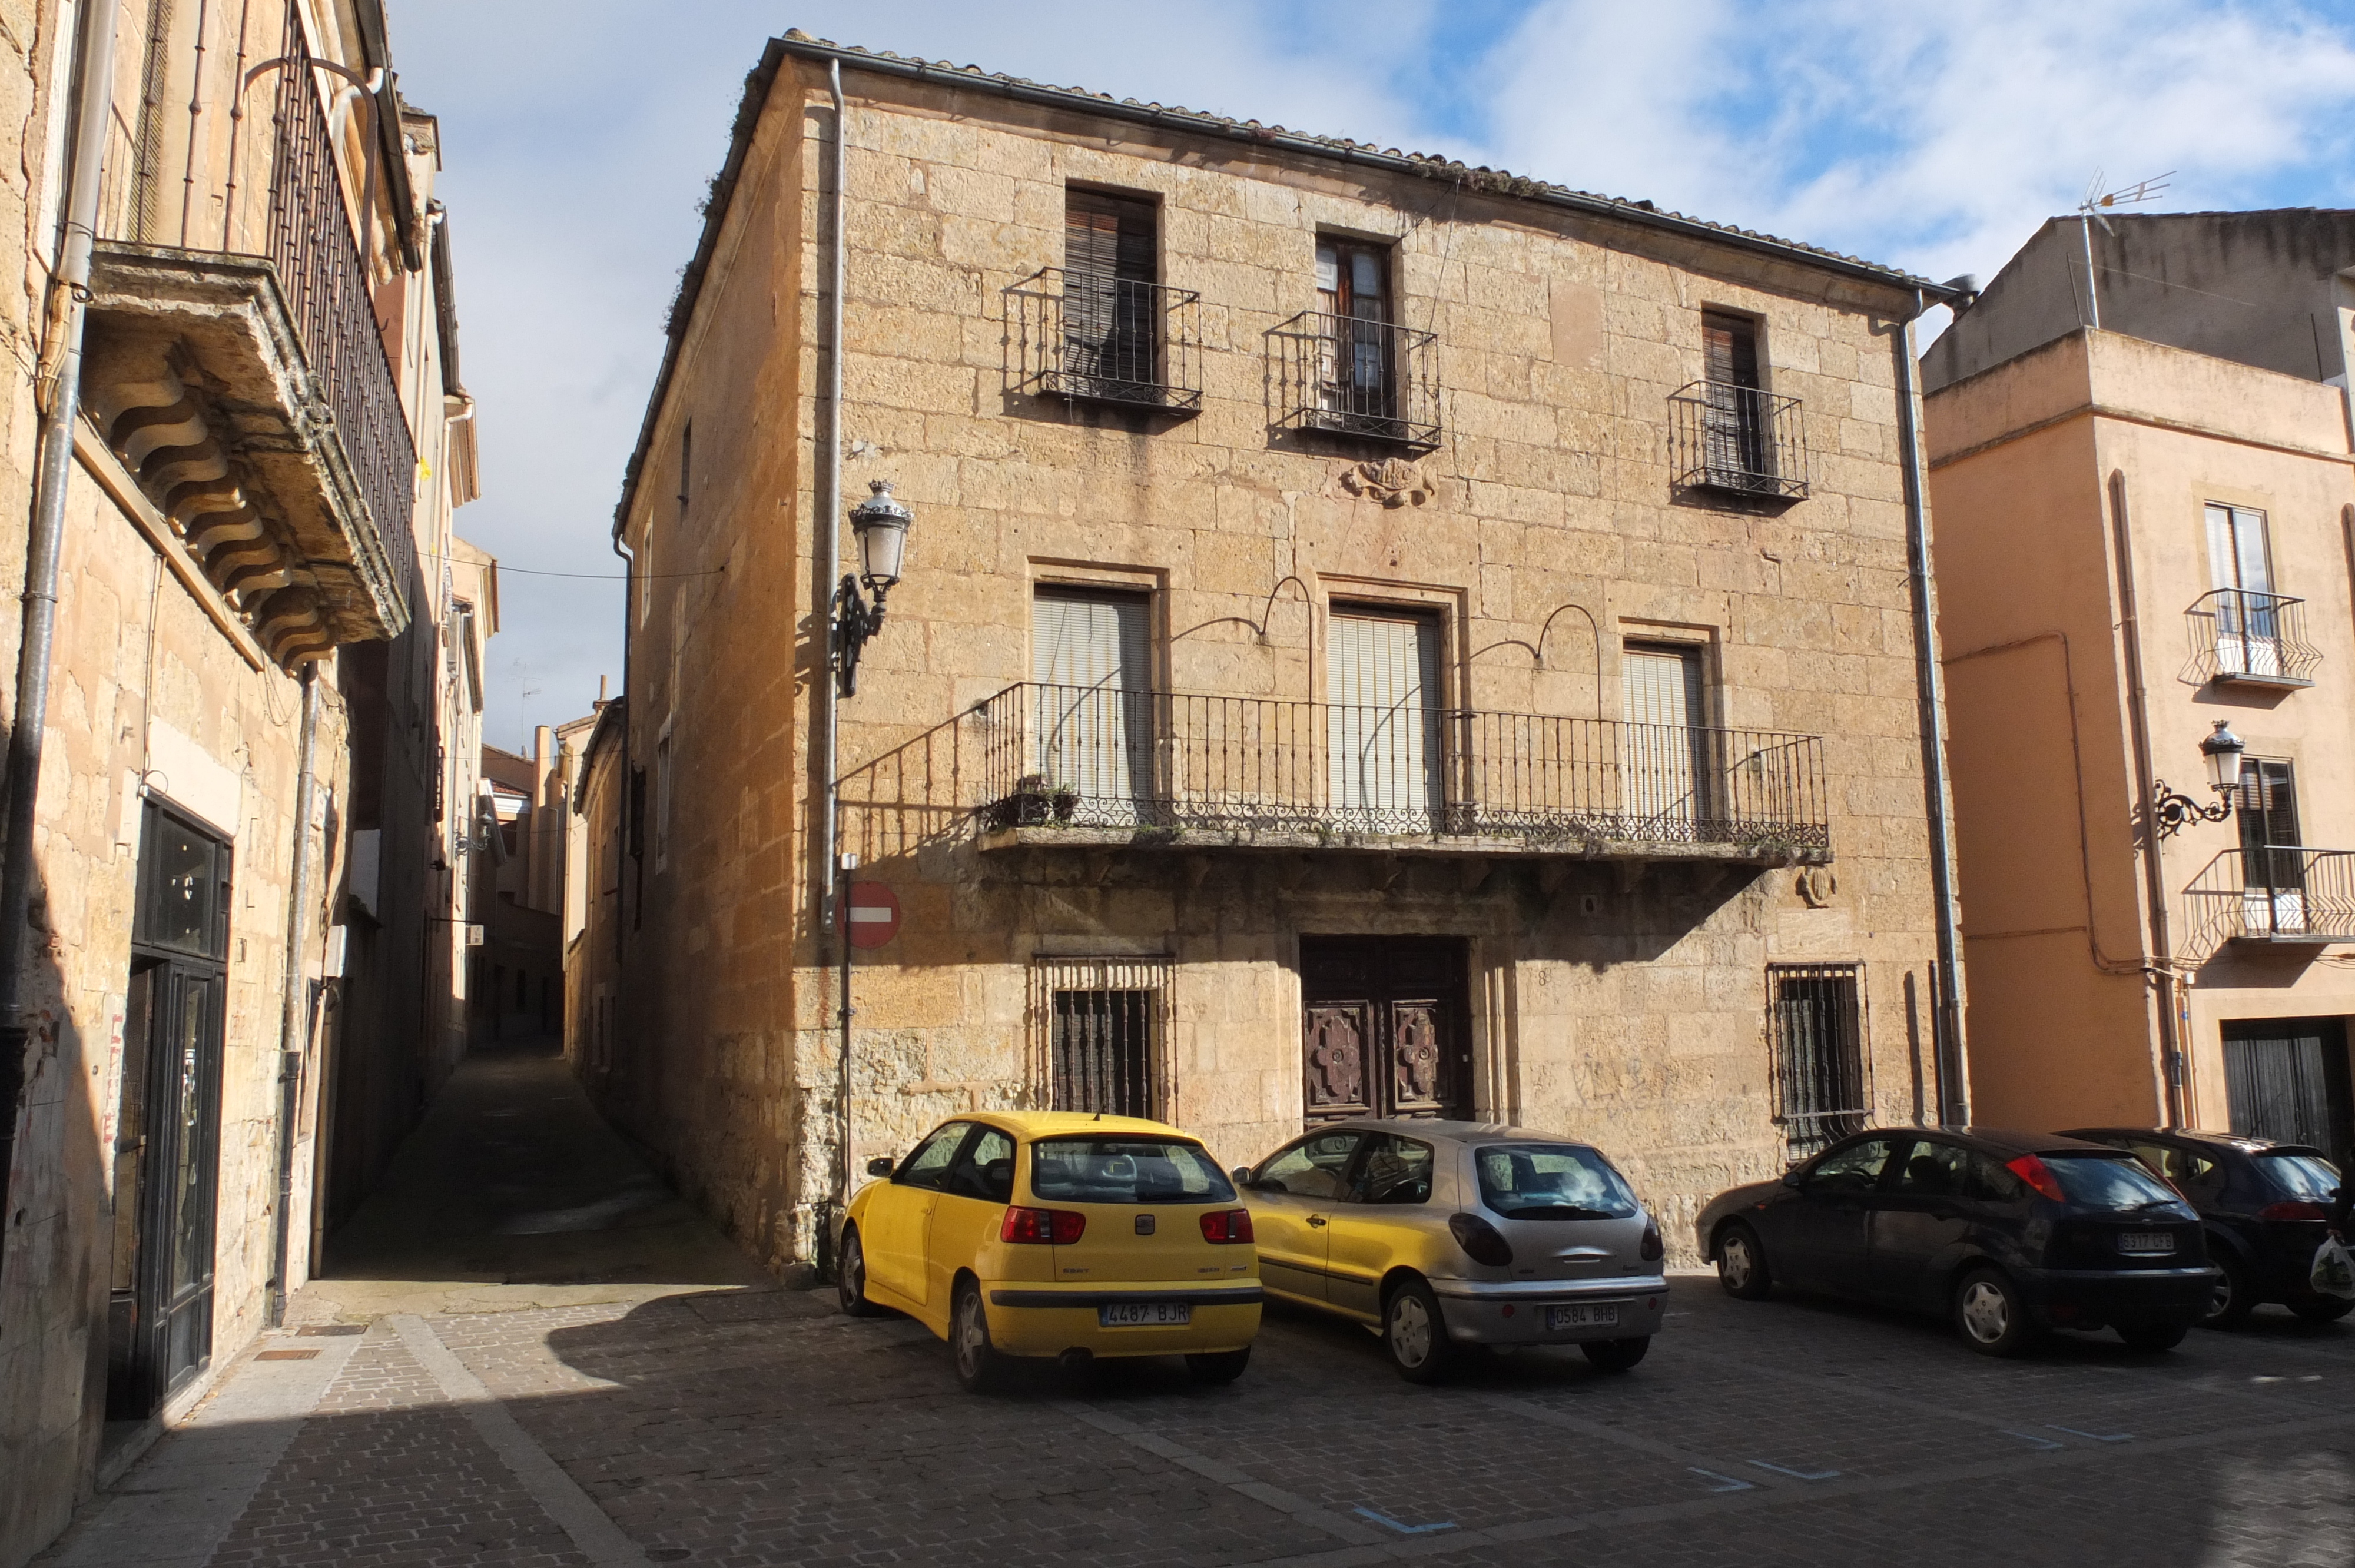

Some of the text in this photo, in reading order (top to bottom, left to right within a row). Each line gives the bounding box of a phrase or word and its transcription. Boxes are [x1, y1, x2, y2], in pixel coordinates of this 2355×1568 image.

[1109, 1305, 1186, 1323] 4487 BJR
[1556, 1306, 1615, 1323] 0584 BHB
